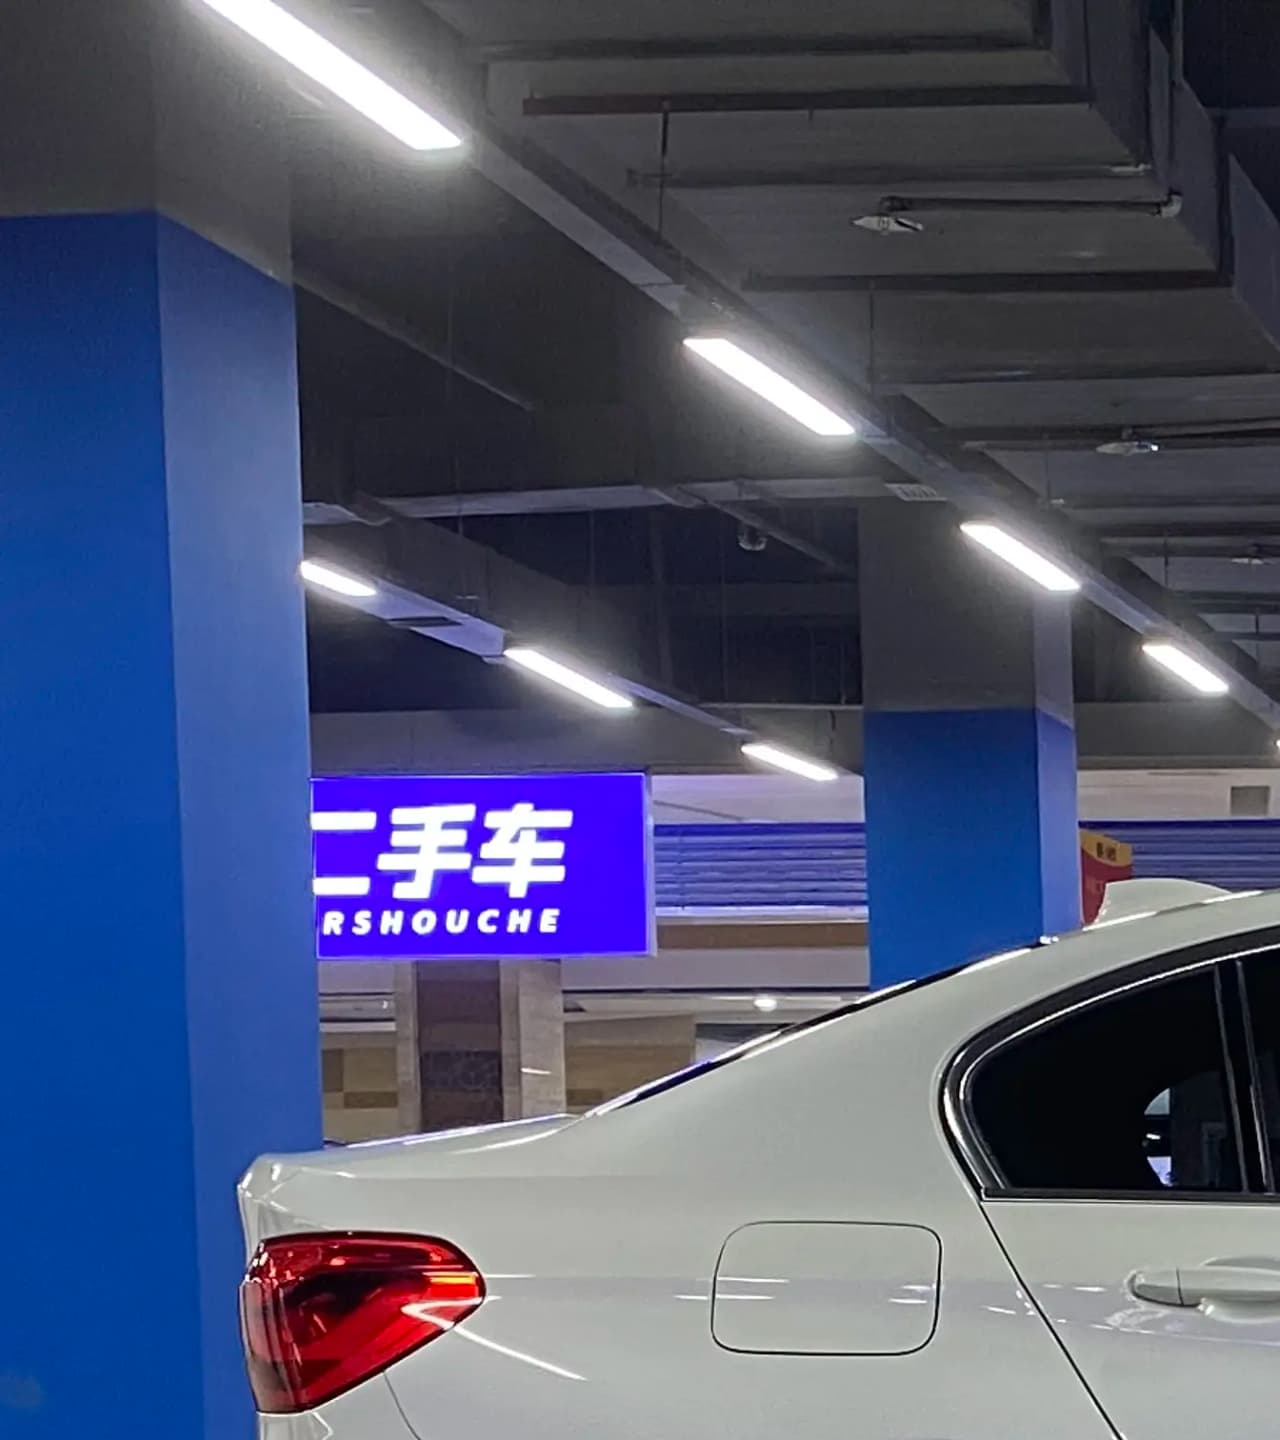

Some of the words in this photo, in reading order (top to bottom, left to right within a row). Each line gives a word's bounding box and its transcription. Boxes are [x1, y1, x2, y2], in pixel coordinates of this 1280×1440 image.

[310, 803, 574, 899] 二手车
[322, 908, 561, 936] RSHOUCHE
